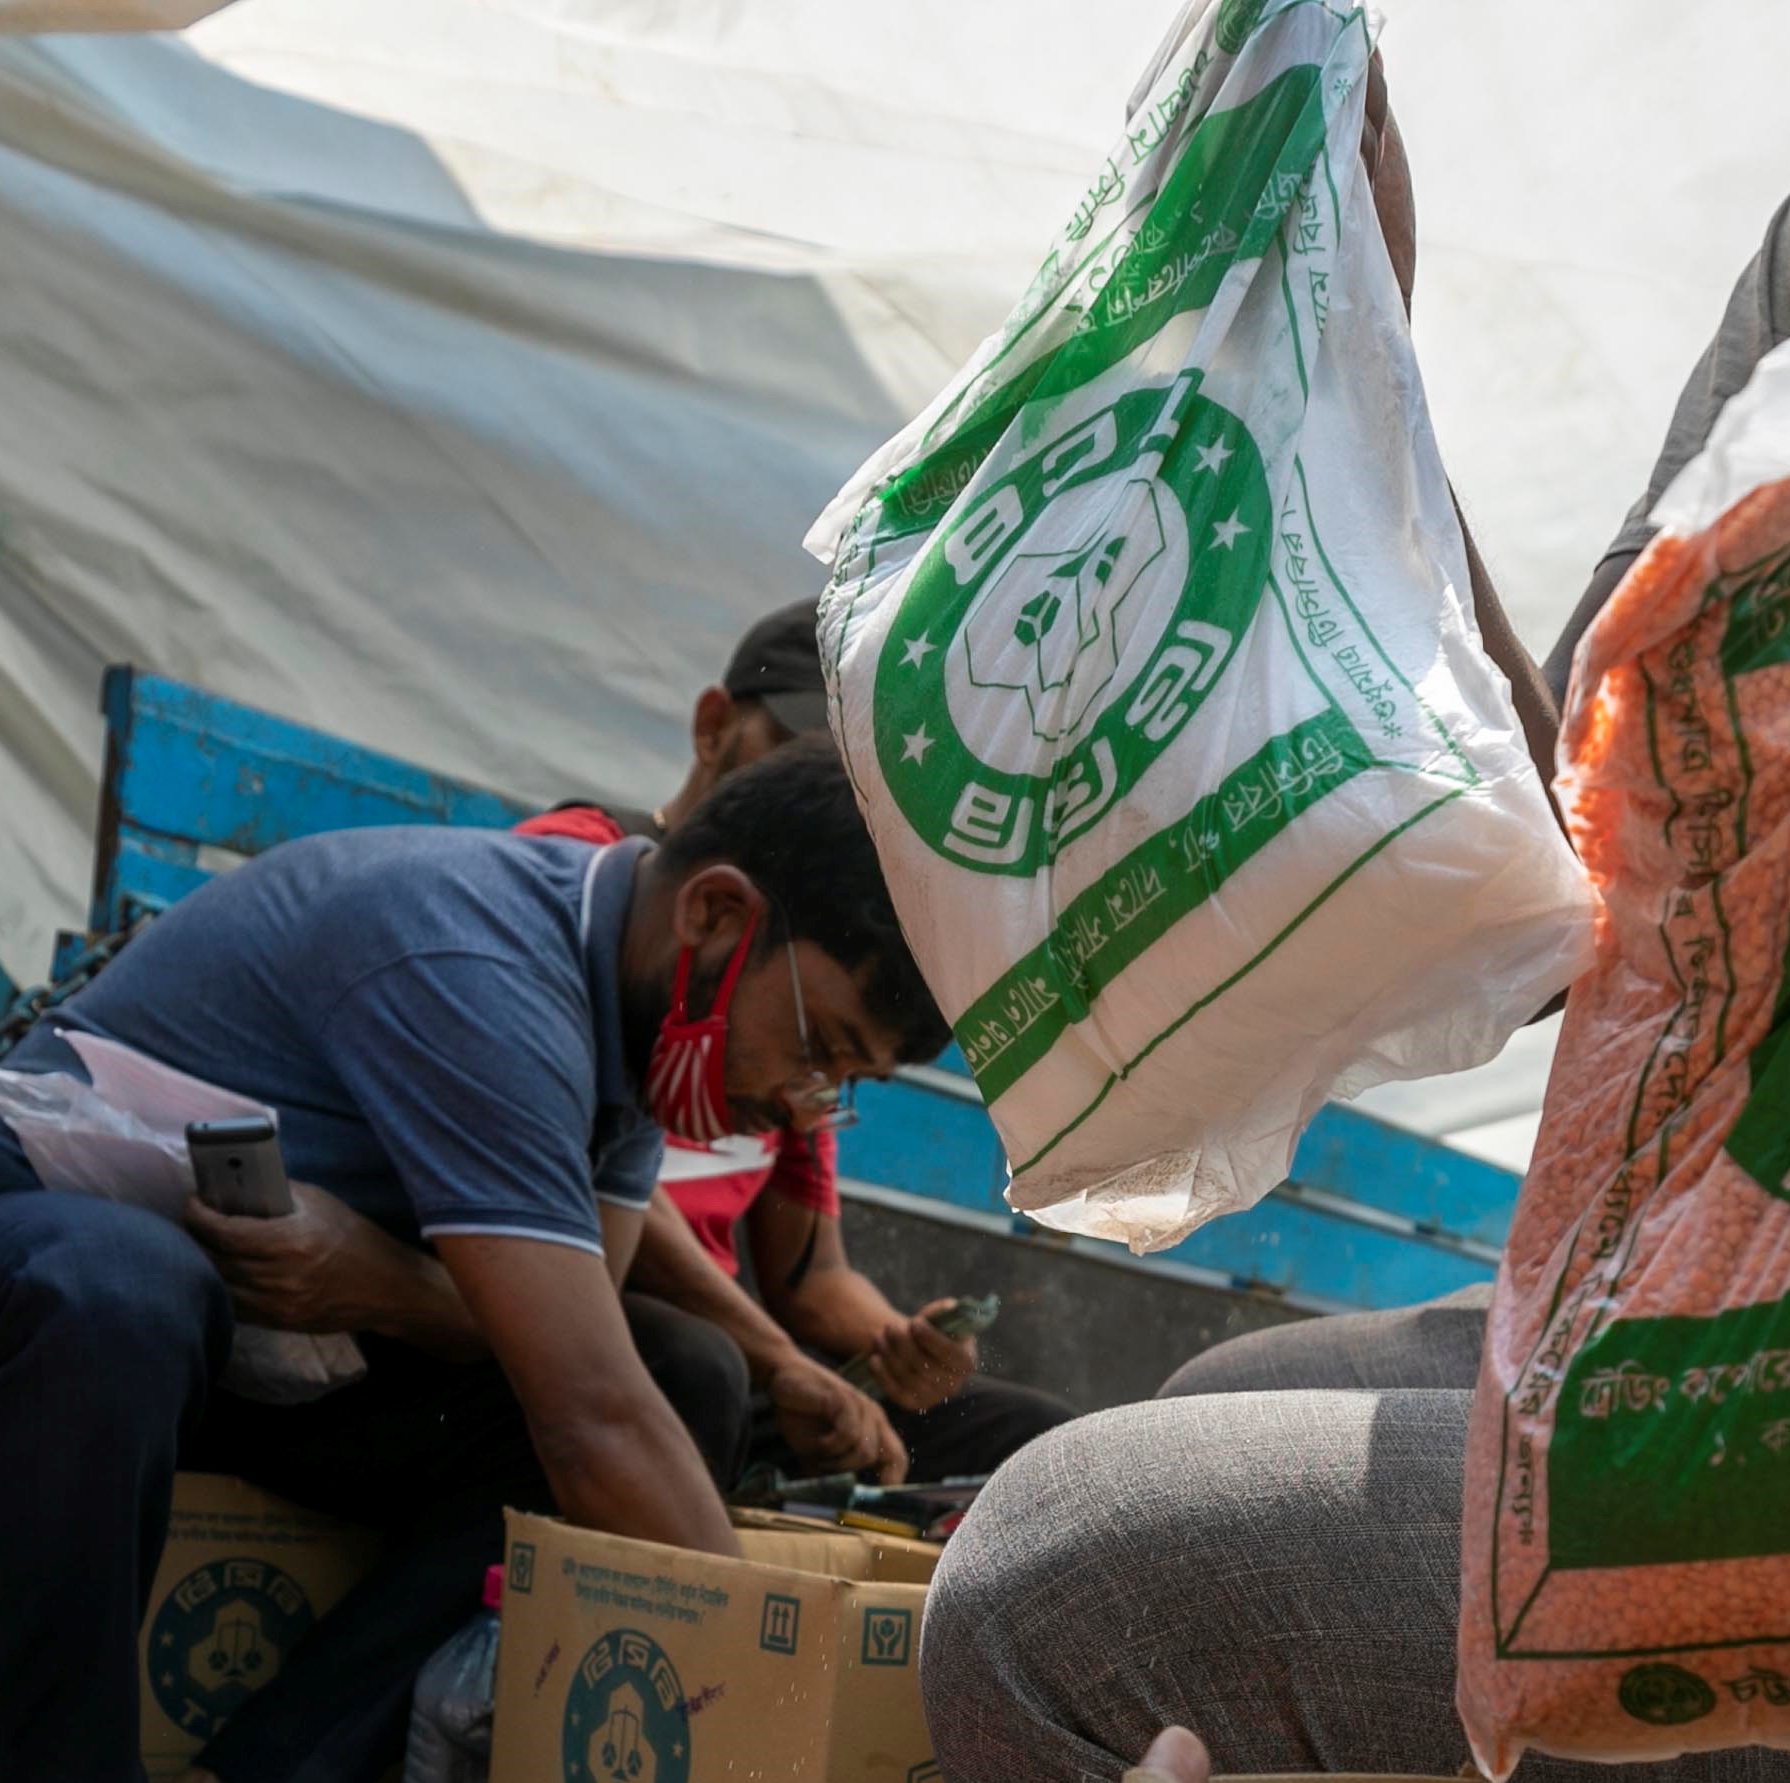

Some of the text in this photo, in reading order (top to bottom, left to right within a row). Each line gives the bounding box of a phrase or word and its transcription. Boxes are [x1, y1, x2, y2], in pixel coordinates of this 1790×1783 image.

[1222, 728, 1343, 832] টিসিবির
[1104, 863, 1168, 933] দামে
[1006, 976, 1060, 1037] মানে
[967, 1017, 1016, 1077] অনন
[583, 1634, 681, 1712] টিসিবি
